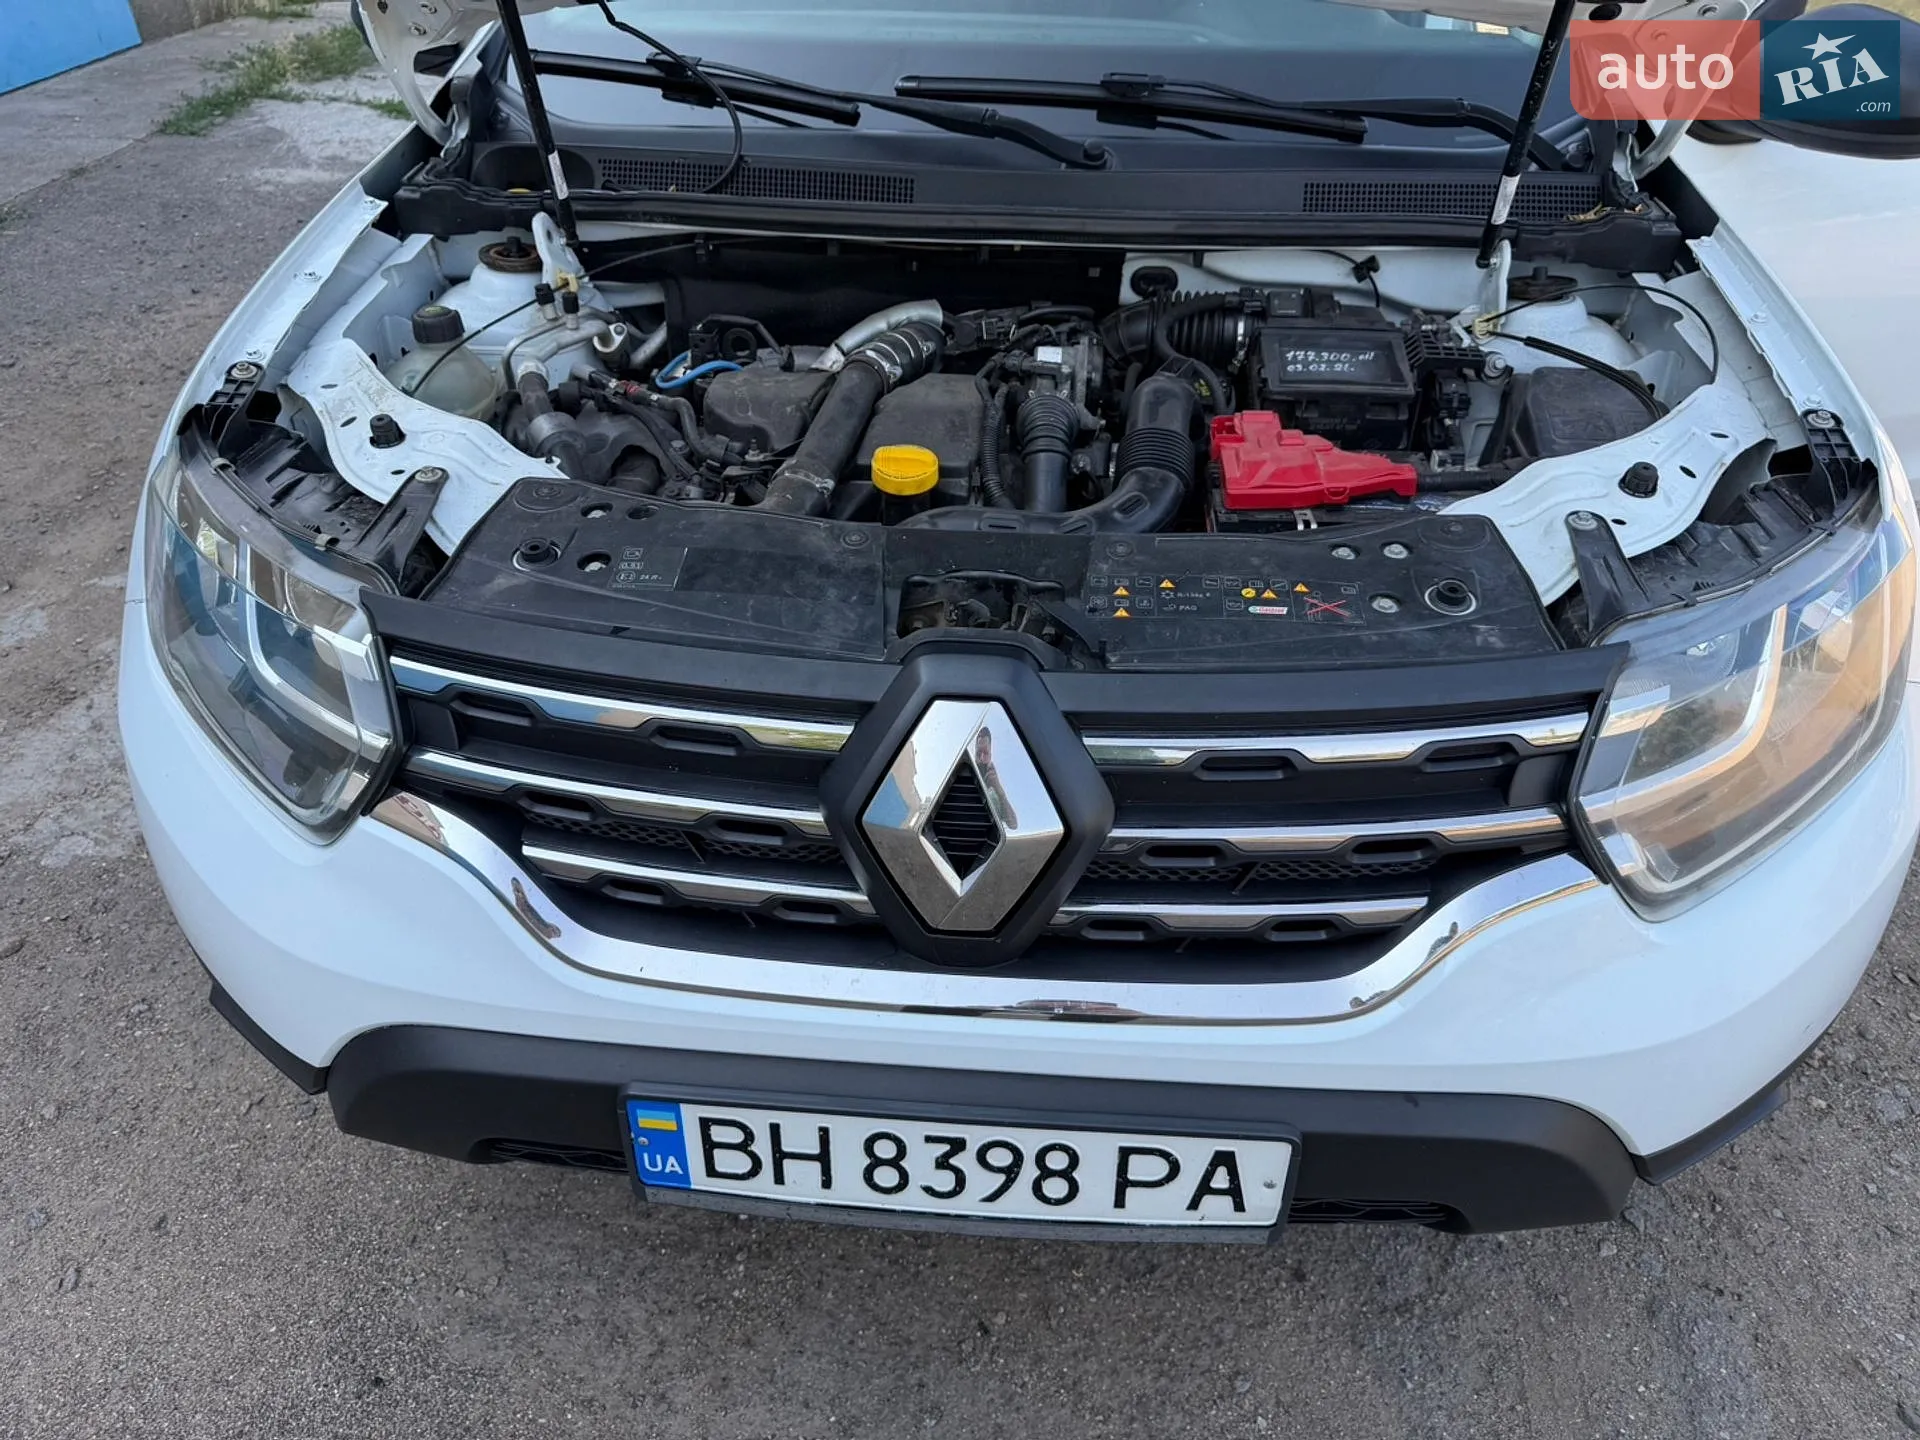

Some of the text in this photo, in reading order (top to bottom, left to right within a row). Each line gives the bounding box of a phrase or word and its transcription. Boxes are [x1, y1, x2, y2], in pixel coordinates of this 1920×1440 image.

[643, 1152, 684, 1175] UA
[698, 1116, 1247, 1213] BH 8398 PA
